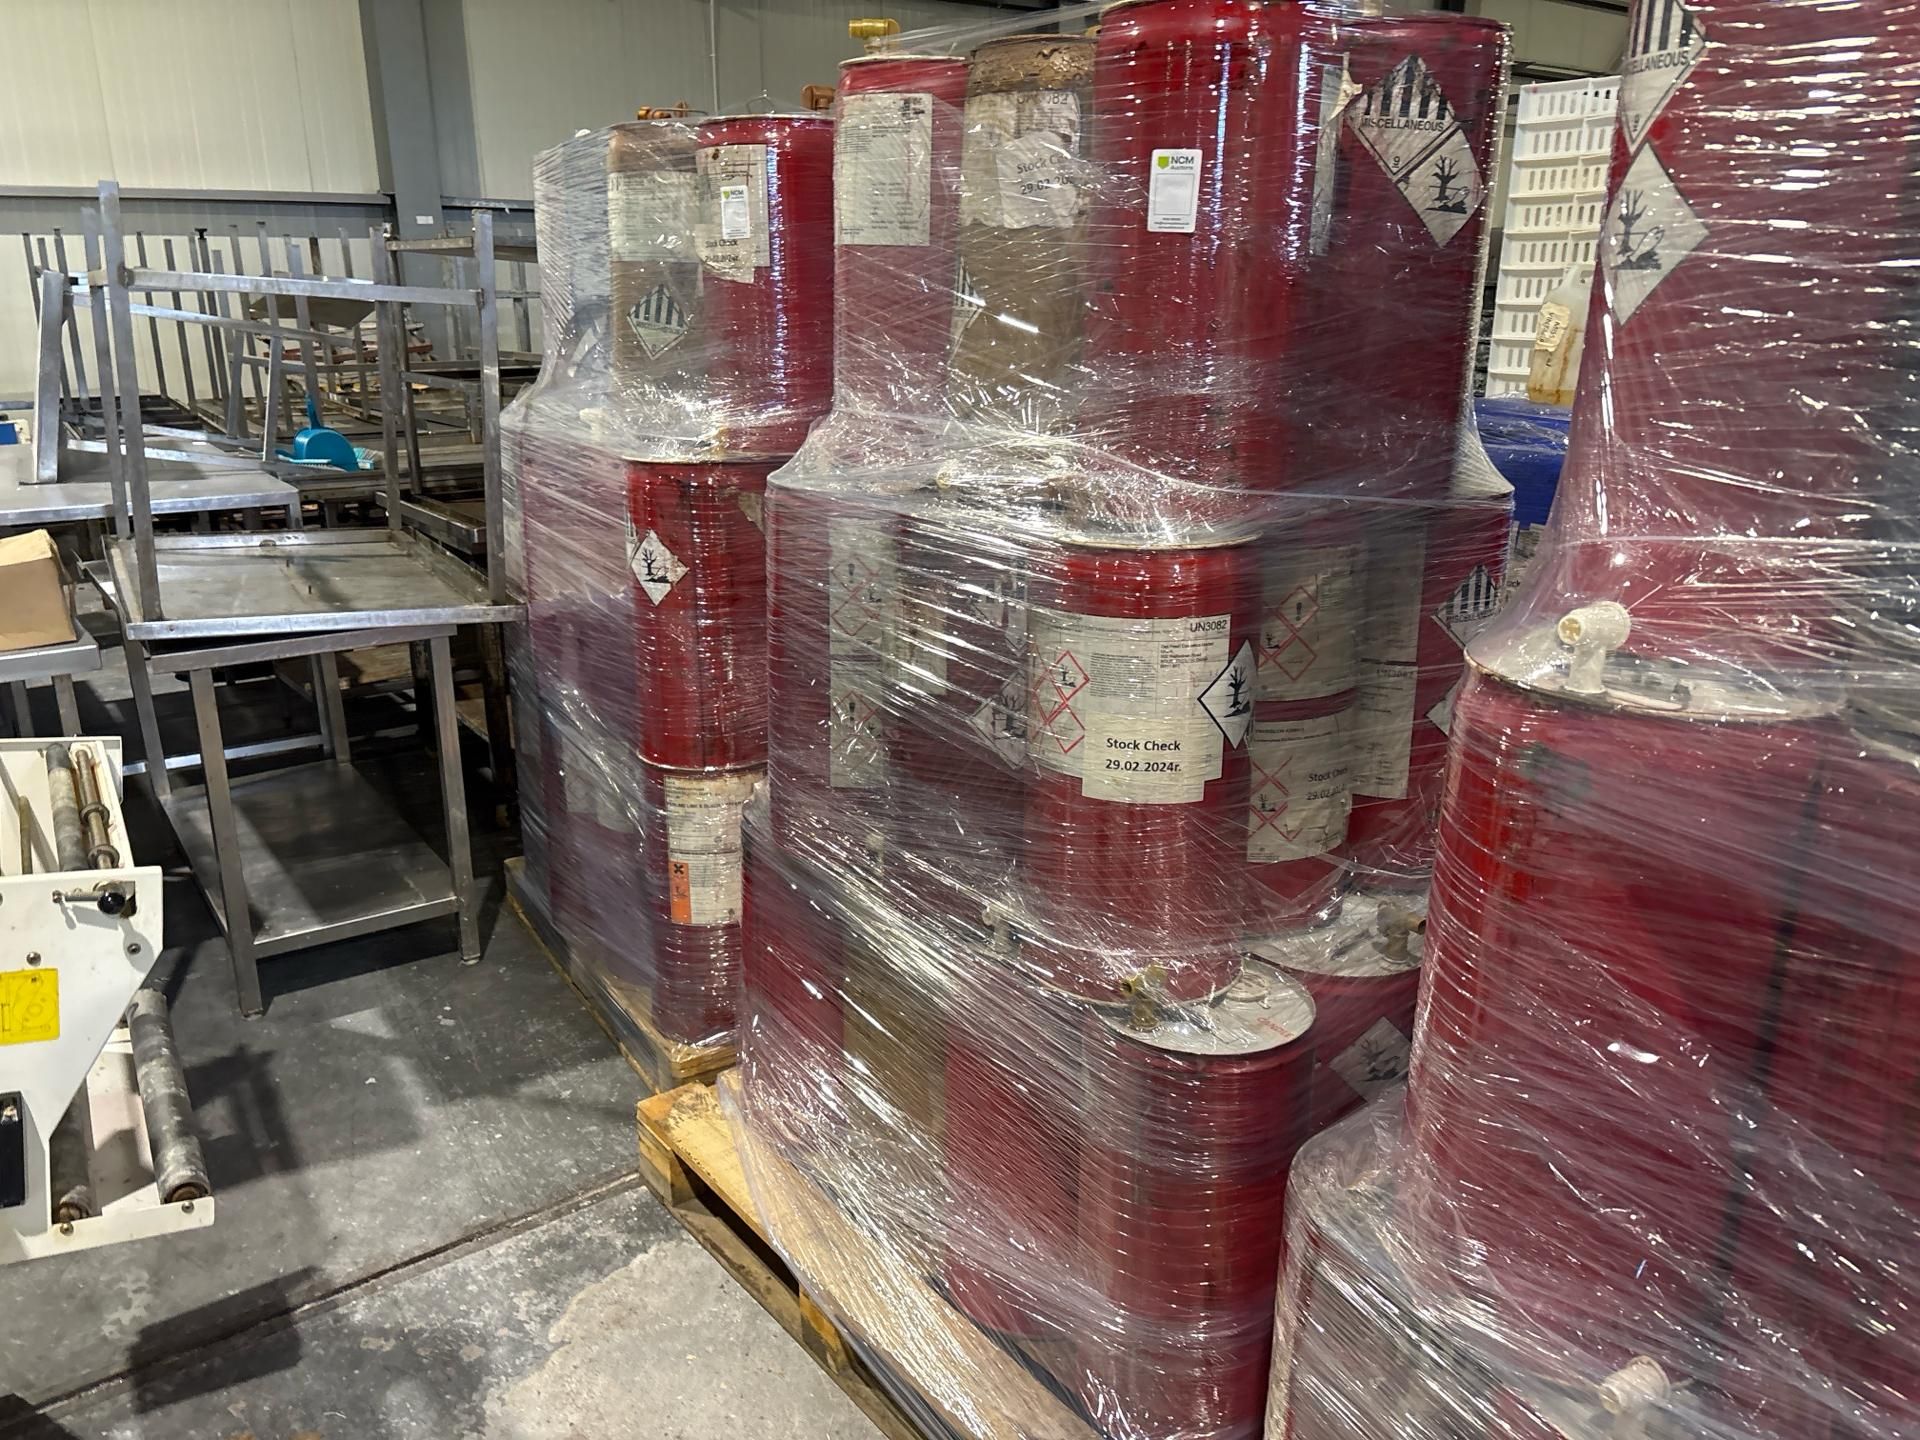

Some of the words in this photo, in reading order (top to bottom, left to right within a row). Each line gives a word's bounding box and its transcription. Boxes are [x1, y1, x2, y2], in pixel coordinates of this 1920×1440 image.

[1170, 156, 1194, 164] NCM
[1393, 156, 1401, 167] 9
[1190, 619, 1227, 633] UN3082
[1106, 737, 1140, 751] Stock
[1144, 740, 1181, 751] Check
[1105, 758, 1182, 773] 29.02.2024r.
